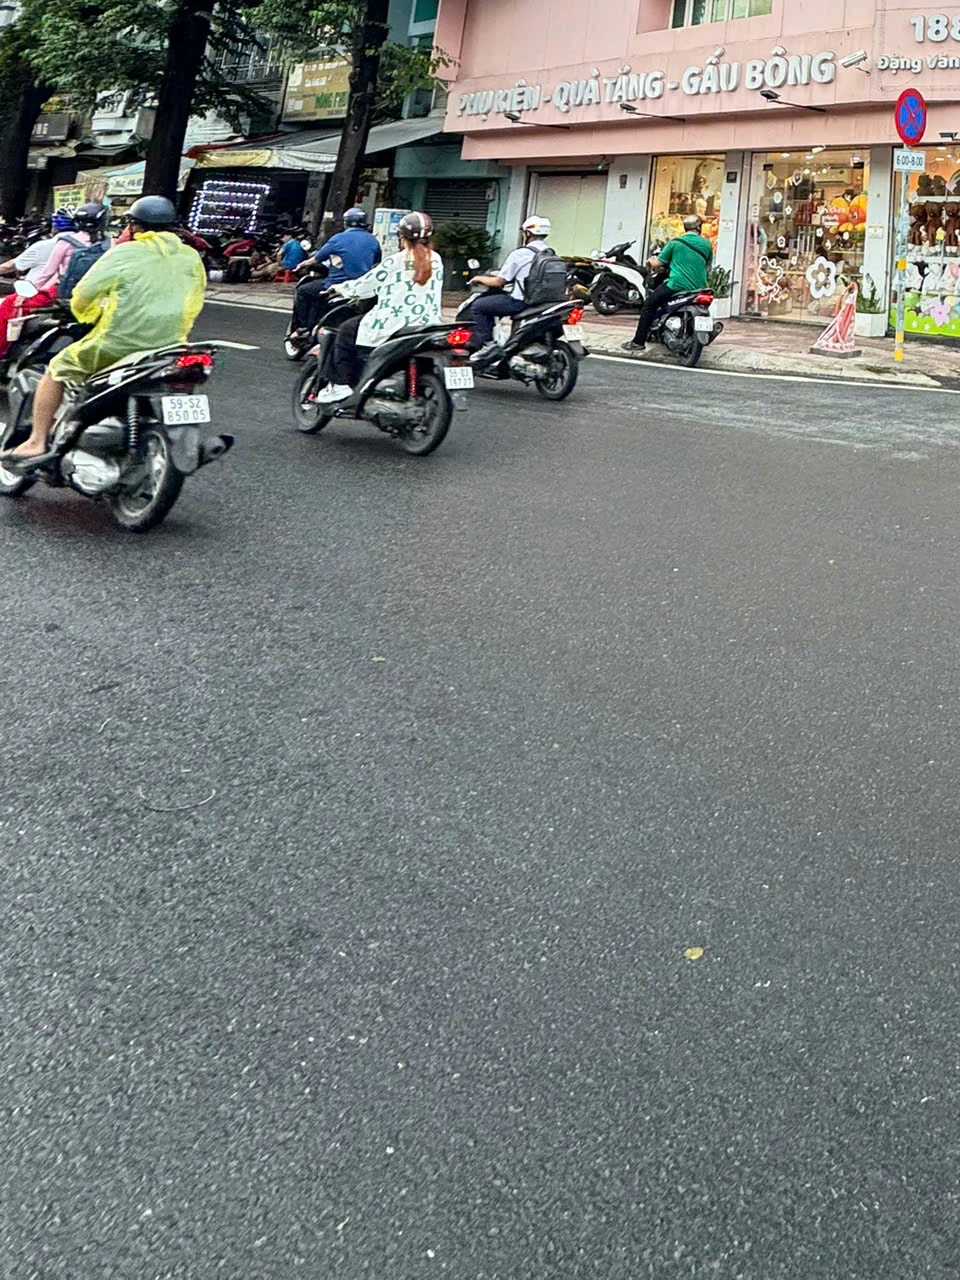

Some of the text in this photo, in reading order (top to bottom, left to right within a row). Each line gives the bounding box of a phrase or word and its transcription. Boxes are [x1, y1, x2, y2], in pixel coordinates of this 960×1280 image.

[877, 54, 923, 75] Đặng
[926, 53, 960, 70] Văn
[553, 67, 600, 113] QUÀ
[682, 47, 741, 96] GẤU
[745, 45, 836, 91] BÔNG
[170, 398, 201, 409] 59-S2
